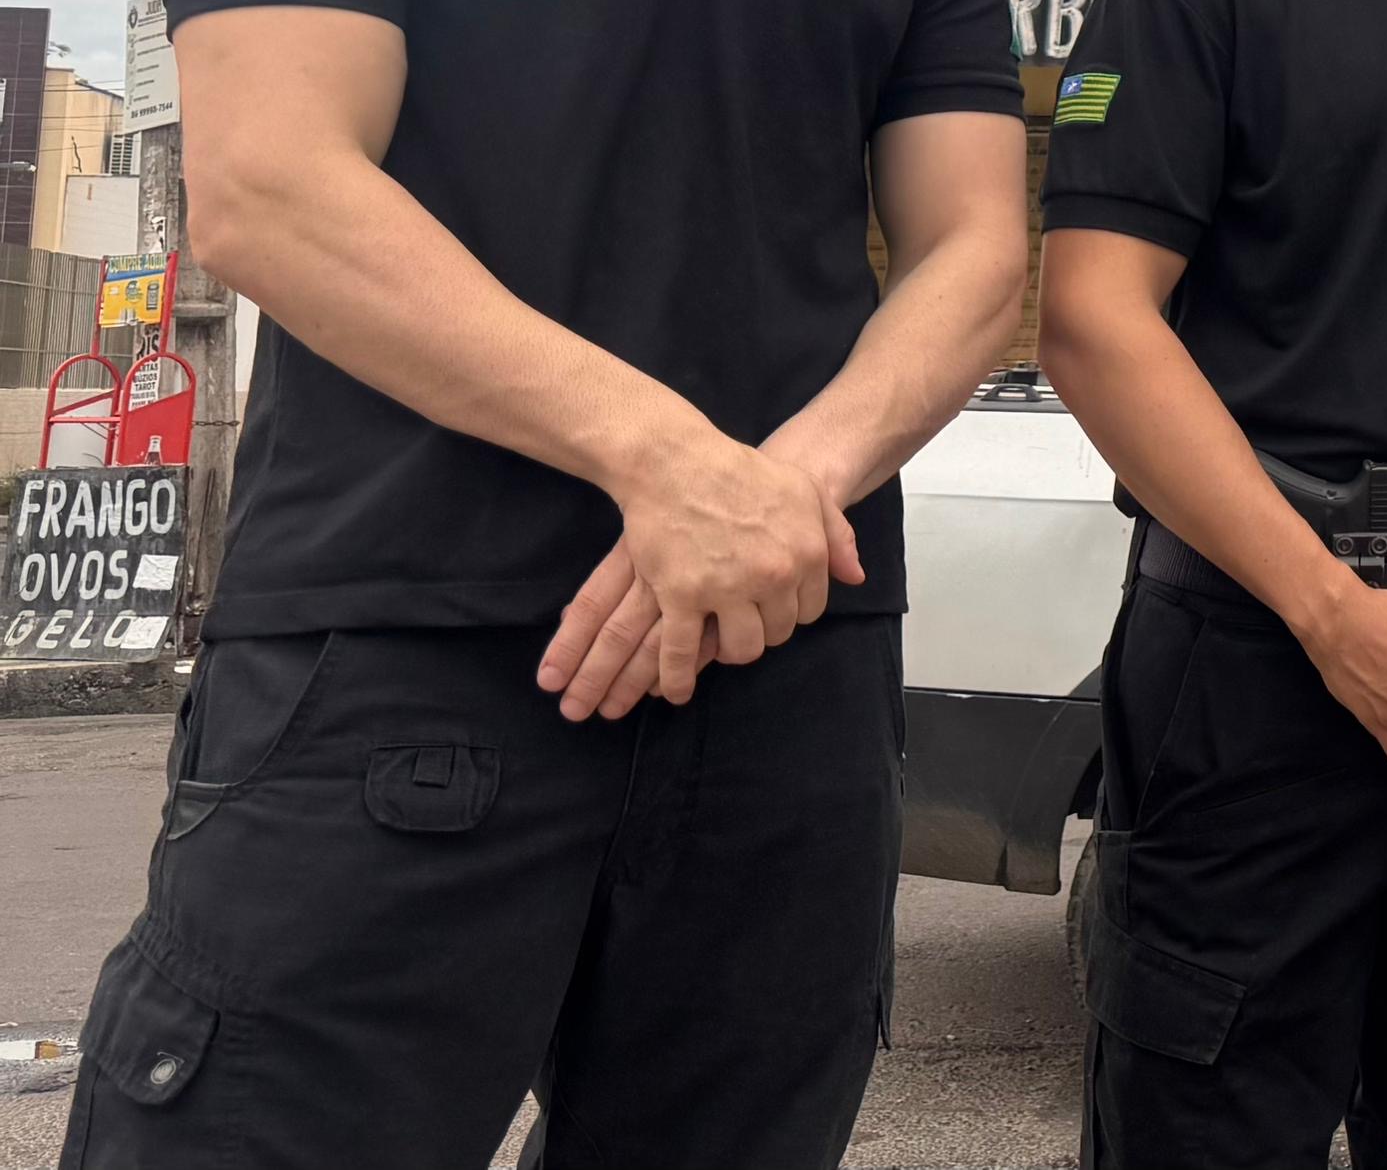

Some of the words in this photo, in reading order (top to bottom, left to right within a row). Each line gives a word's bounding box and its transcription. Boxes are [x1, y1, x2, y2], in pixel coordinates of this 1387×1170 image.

[109, 256, 143, 273] COMPRE
[134, 382, 157, 391] TAROT
[16, 478, 177, 539] FRANGO
[18, 549, 130, 602] OVOS
[3, 608, 137, 649] GELO
